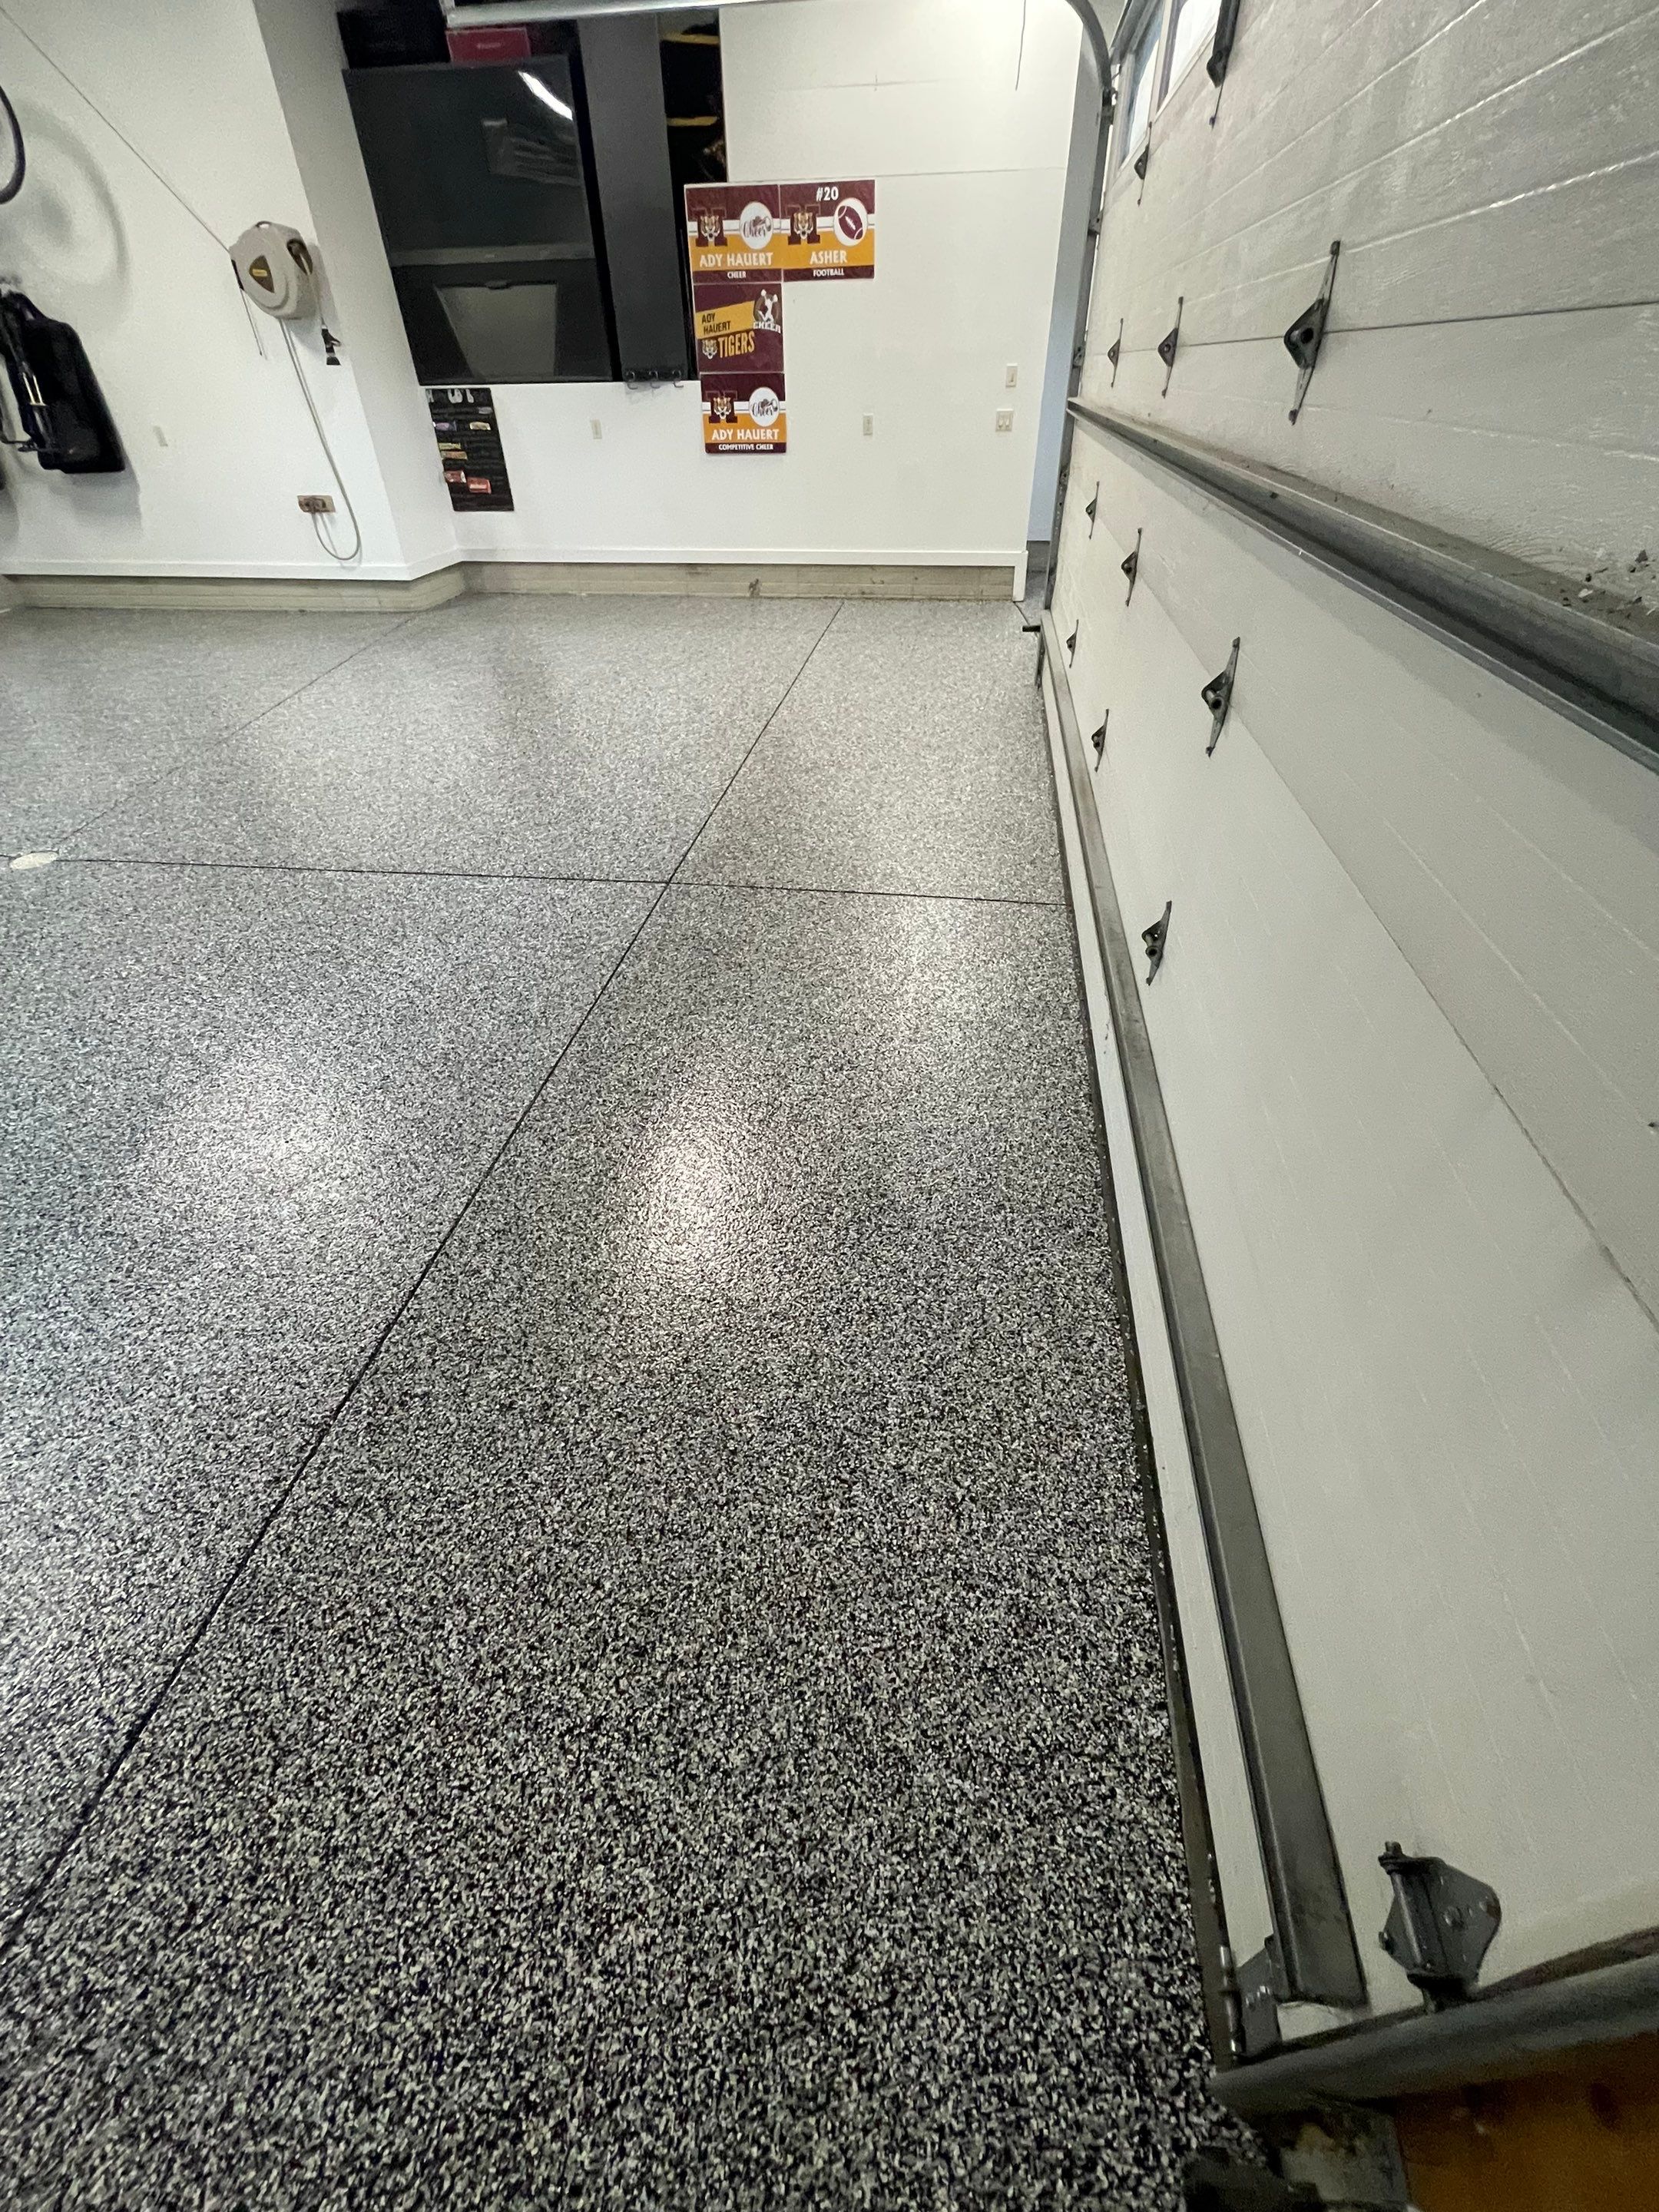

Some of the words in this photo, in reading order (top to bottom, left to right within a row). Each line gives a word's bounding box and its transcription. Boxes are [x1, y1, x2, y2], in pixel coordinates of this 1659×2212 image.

[816, 186, 839, 201] #20
[700, 253, 723, 267] ADY
[727, 252, 773, 267] HAUERT
[810, 250, 847, 265] ASHER
[727, 270, 747, 279] CHEER
[813, 268, 845, 277] FOOTBALL
[701, 313, 716, 323] ADY
[704, 321, 731, 335] HAUERT
[753, 321, 782, 333] CHEER
[718, 330, 756, 359] TIGERS
[711, 429, 734, 441] ADY
[737, 429, 780, 440] HAUERT
[718, 443, 755, 452] COMPETITIVE
